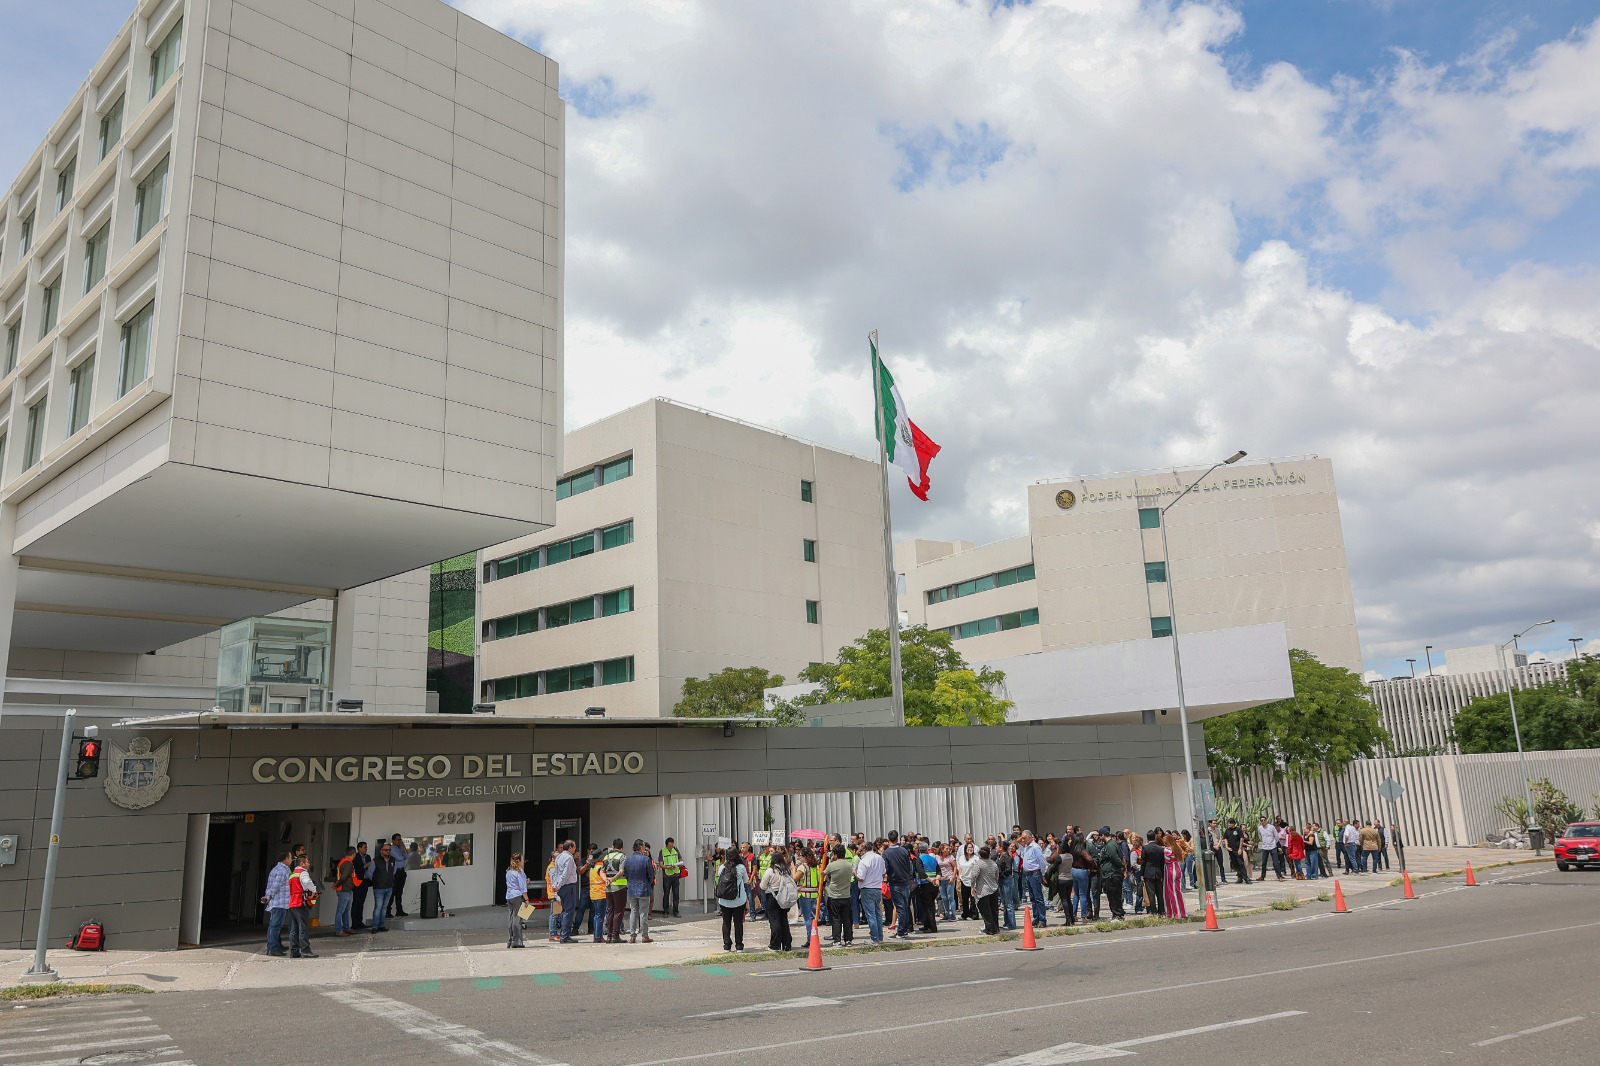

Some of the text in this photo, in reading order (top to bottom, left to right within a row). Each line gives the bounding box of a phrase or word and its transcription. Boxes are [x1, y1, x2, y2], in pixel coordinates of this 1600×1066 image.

[1081, 472, 1306, 502] PODER JUDICIAL DE LA FEDERACIÓN
[252, 751, 644, 783] CONGRESO DEL ESTADO
[398, 784, 526, 798] PODER LEGISLATIVO
[437, 811, 475, 825] 2920
